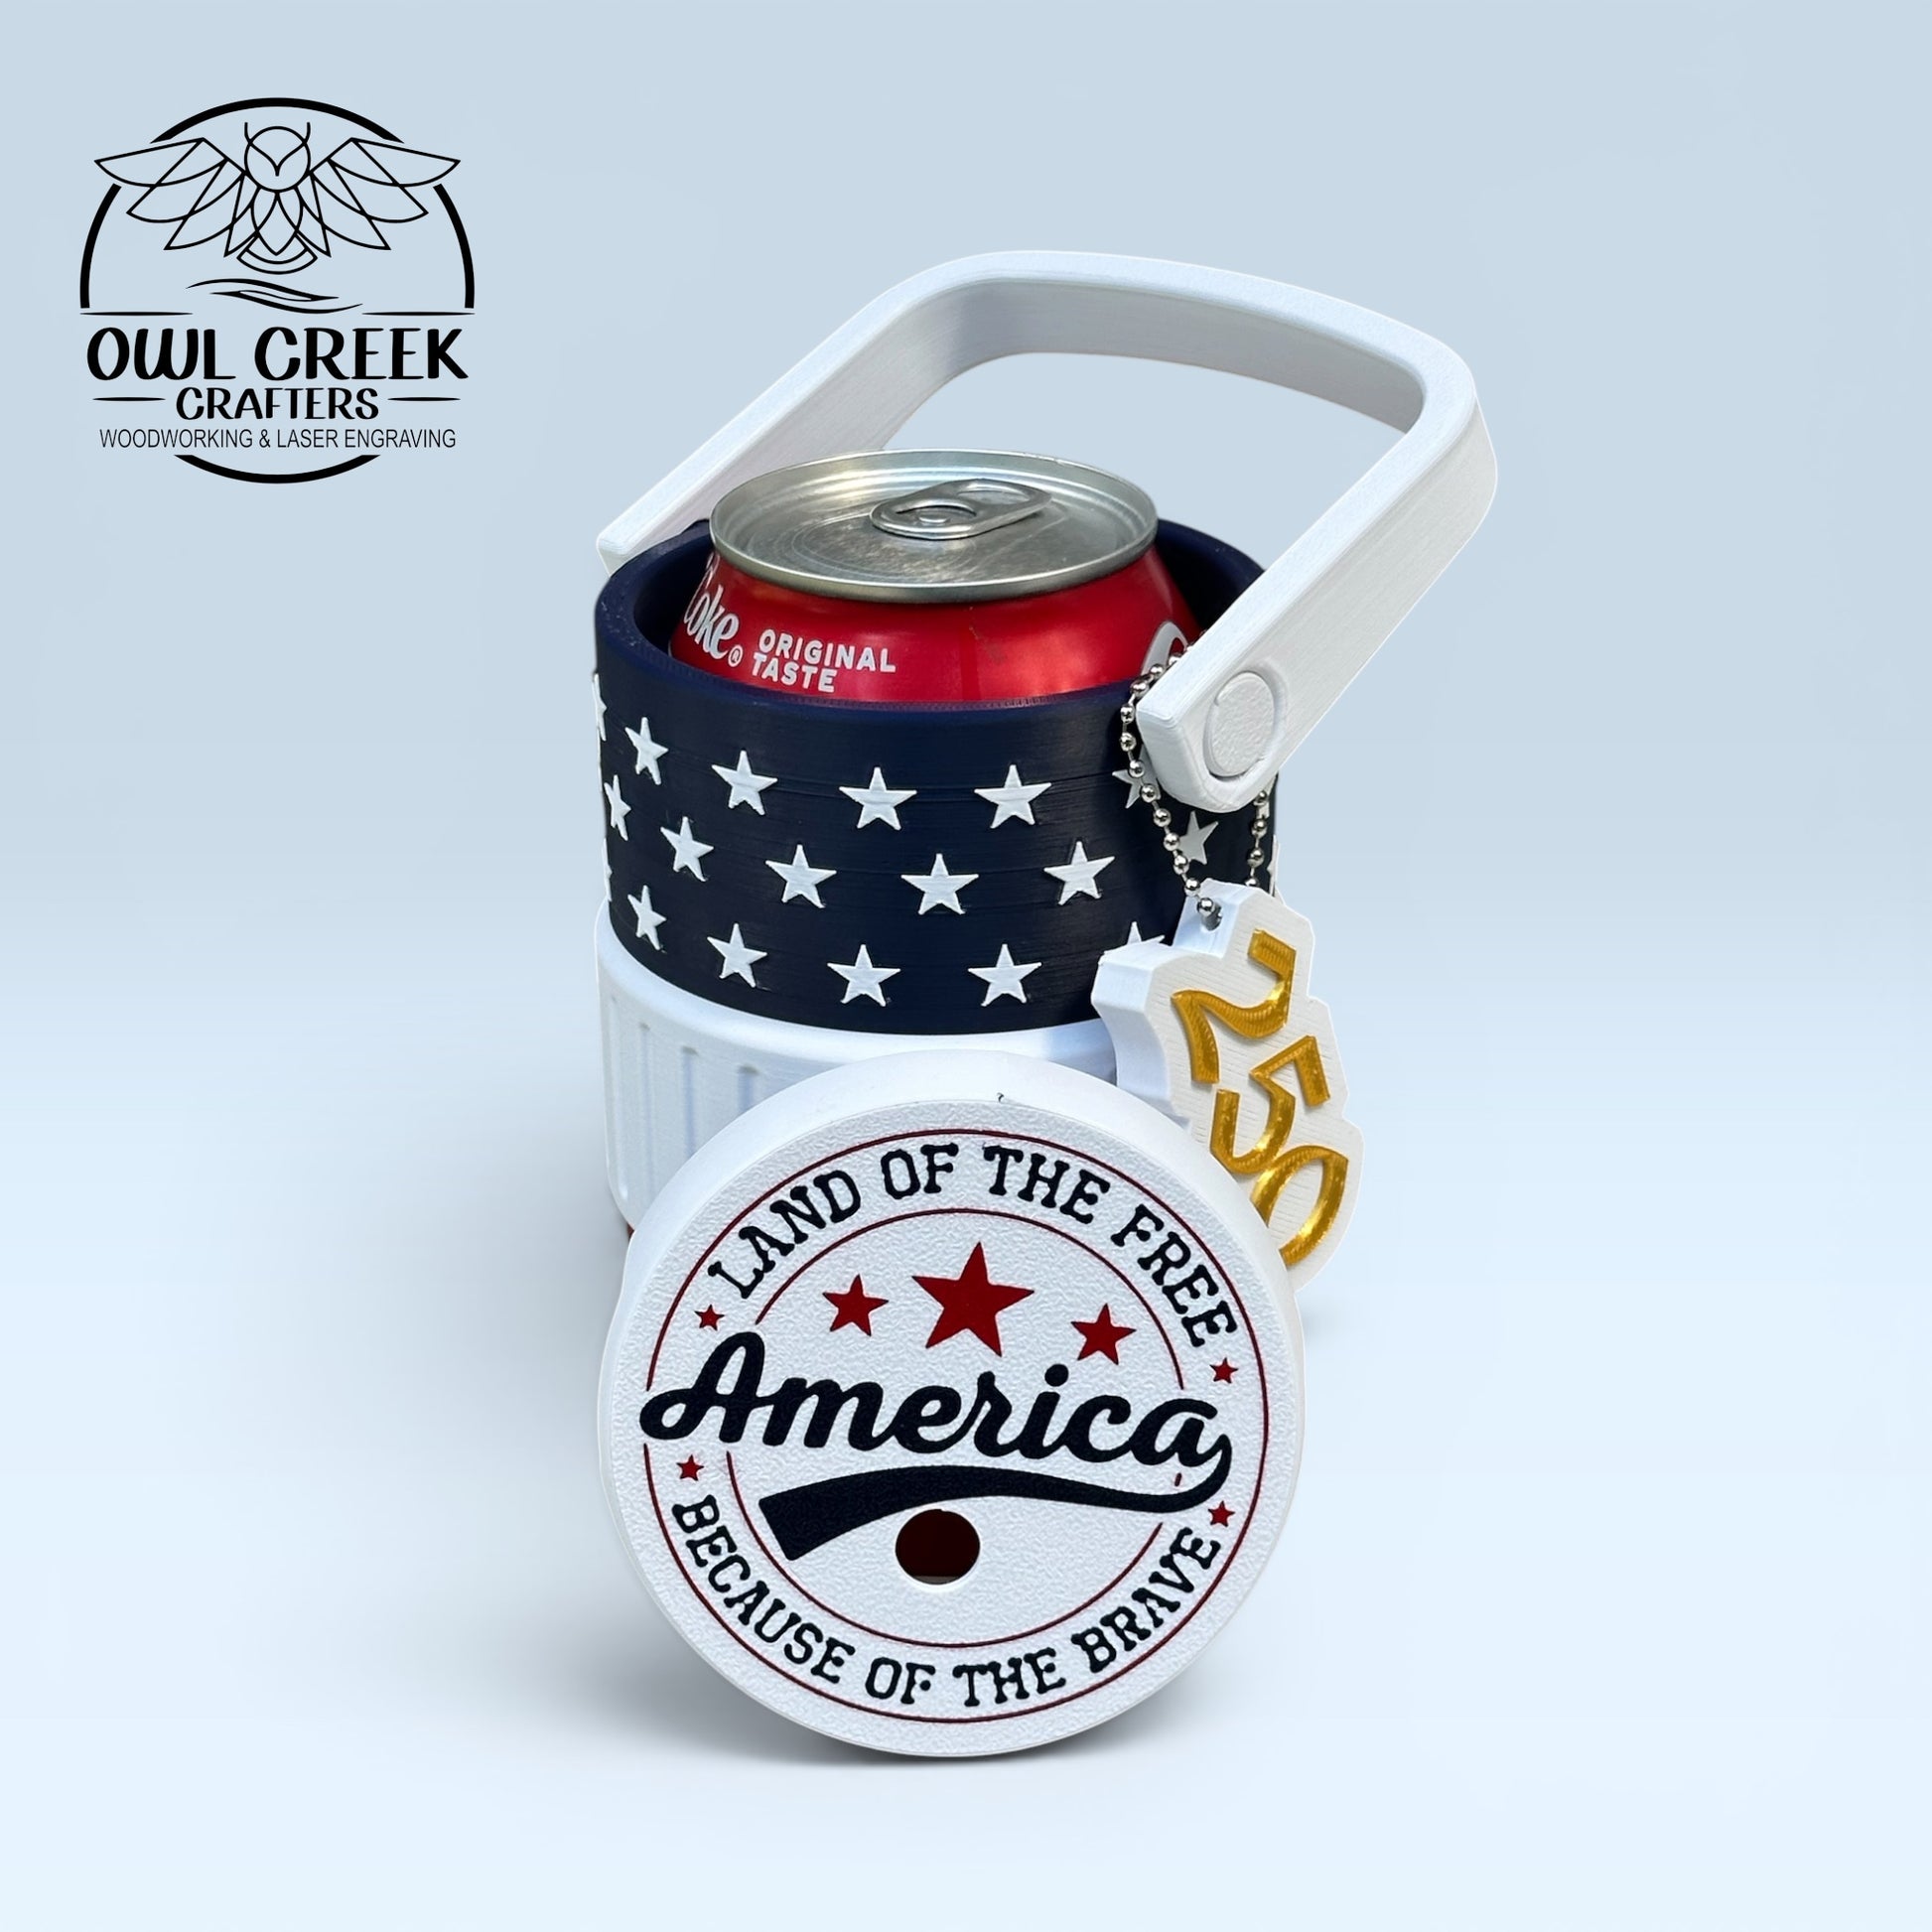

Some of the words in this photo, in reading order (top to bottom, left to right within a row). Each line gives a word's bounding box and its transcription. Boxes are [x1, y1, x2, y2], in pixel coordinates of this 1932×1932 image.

[752, 651, 838, 693] TASTE
[759, 628, 897, 673] ORIGINAL
[1171, 928, 1348, 1267] 250
[707, 1168, 862, 1300] LAND
[880, 1143, 960, 1199] OF
[982, 1144, 1111, 1226] THE
[1110, 1203, 1238, 1348] FREE
[638, 1330, 1233, 1514] America
[671, 1494, 856, 1685] BECAUSE
[864, 1656, 936, 1706] OF
[951, 1647, 1068, 1709] THE
[1070, 1526, 1222, 1675] BRAVE
